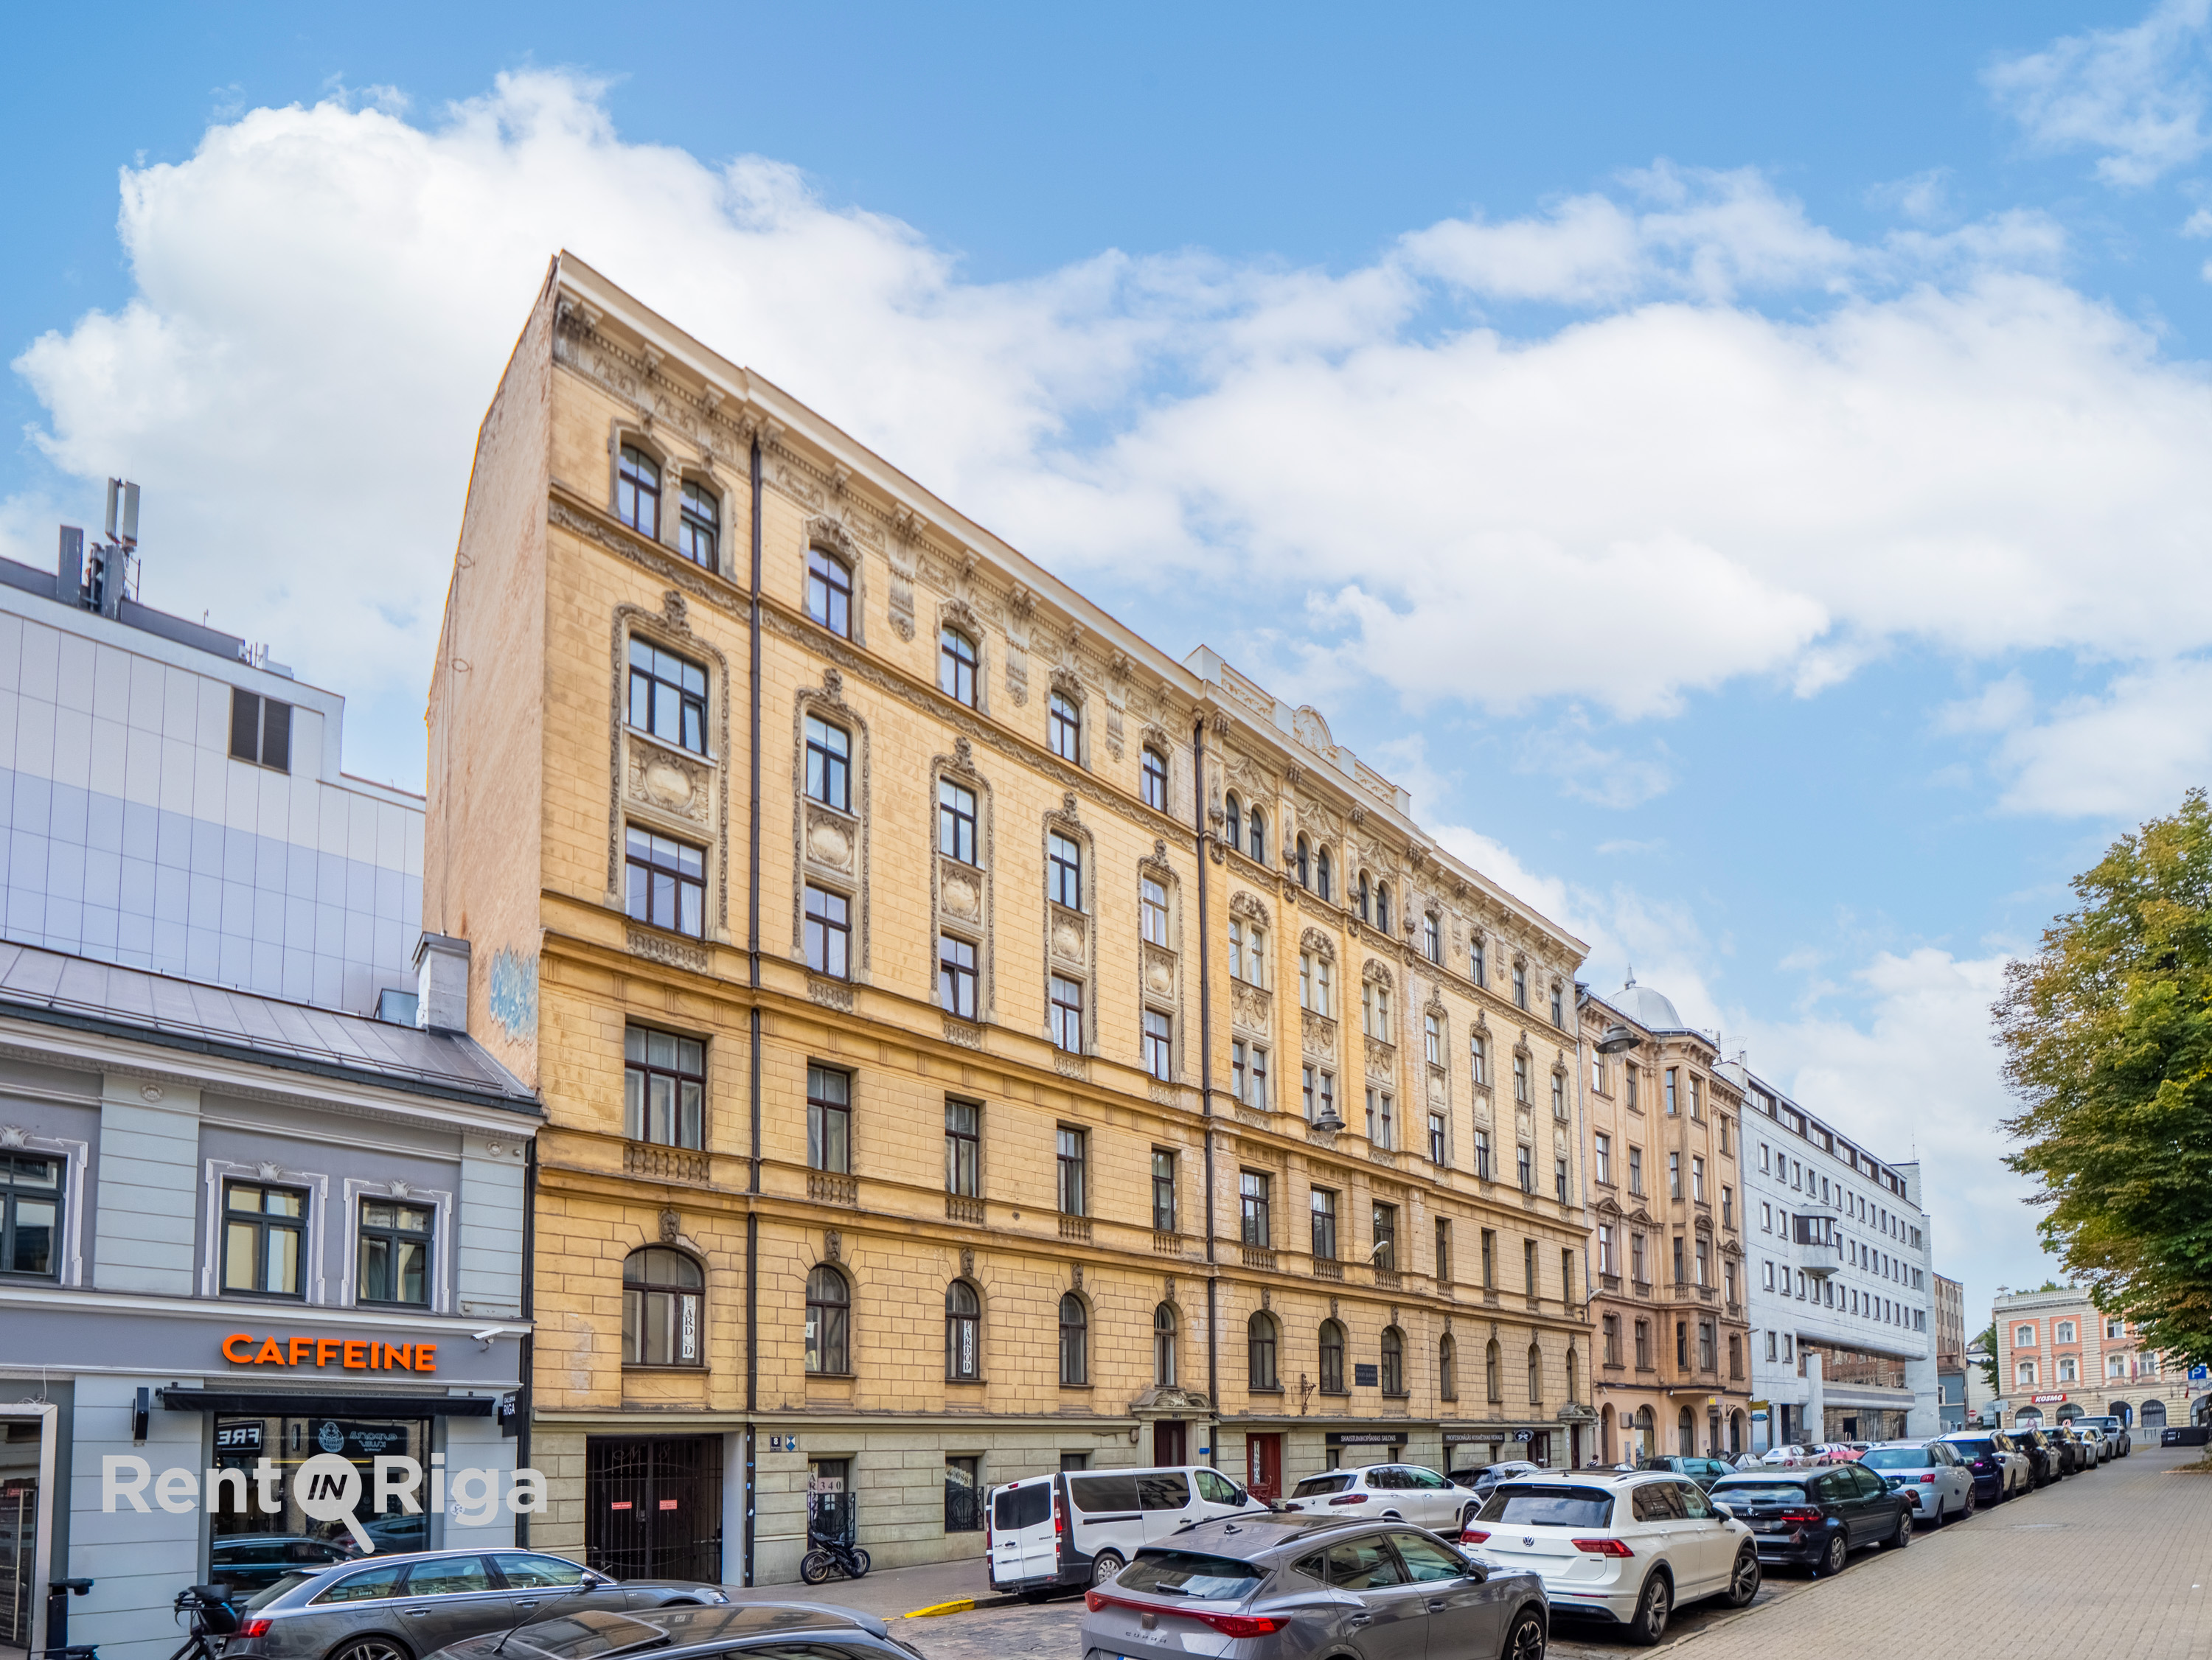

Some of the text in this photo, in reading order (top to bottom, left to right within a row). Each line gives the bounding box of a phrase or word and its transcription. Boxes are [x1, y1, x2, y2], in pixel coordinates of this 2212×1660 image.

[223, 1334, 437, 1371] CAFFEINE
[2035, 1394, 2063, 1403] KOSMO
[503, 1403, 515, 1415] RIGA
[820, 1482, 841, 1491] 340
[1125, 1631, 1167, 1644] CUPRA
